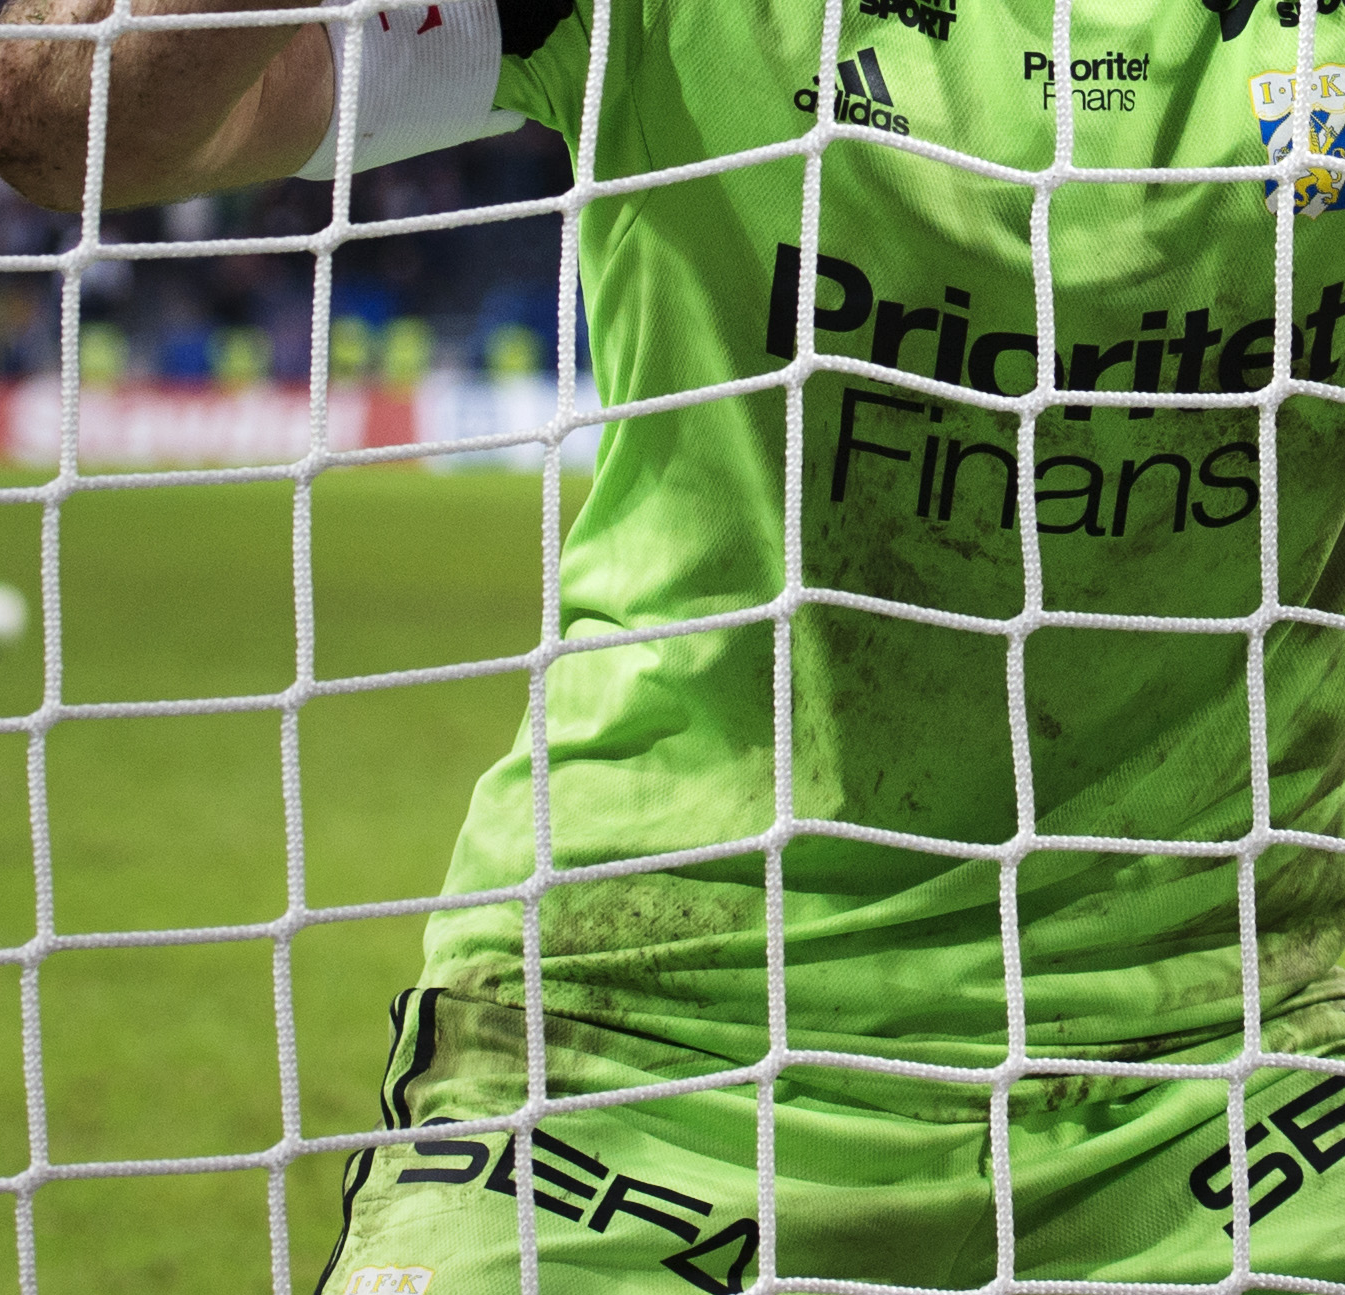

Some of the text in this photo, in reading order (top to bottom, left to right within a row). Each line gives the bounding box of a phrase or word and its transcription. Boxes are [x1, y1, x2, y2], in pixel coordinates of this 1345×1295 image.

[1023, 51, 1150, 81] Proritet
[1043, 82, 1136, 112] Fnans
[830, 387, 1260, 538] Finans
